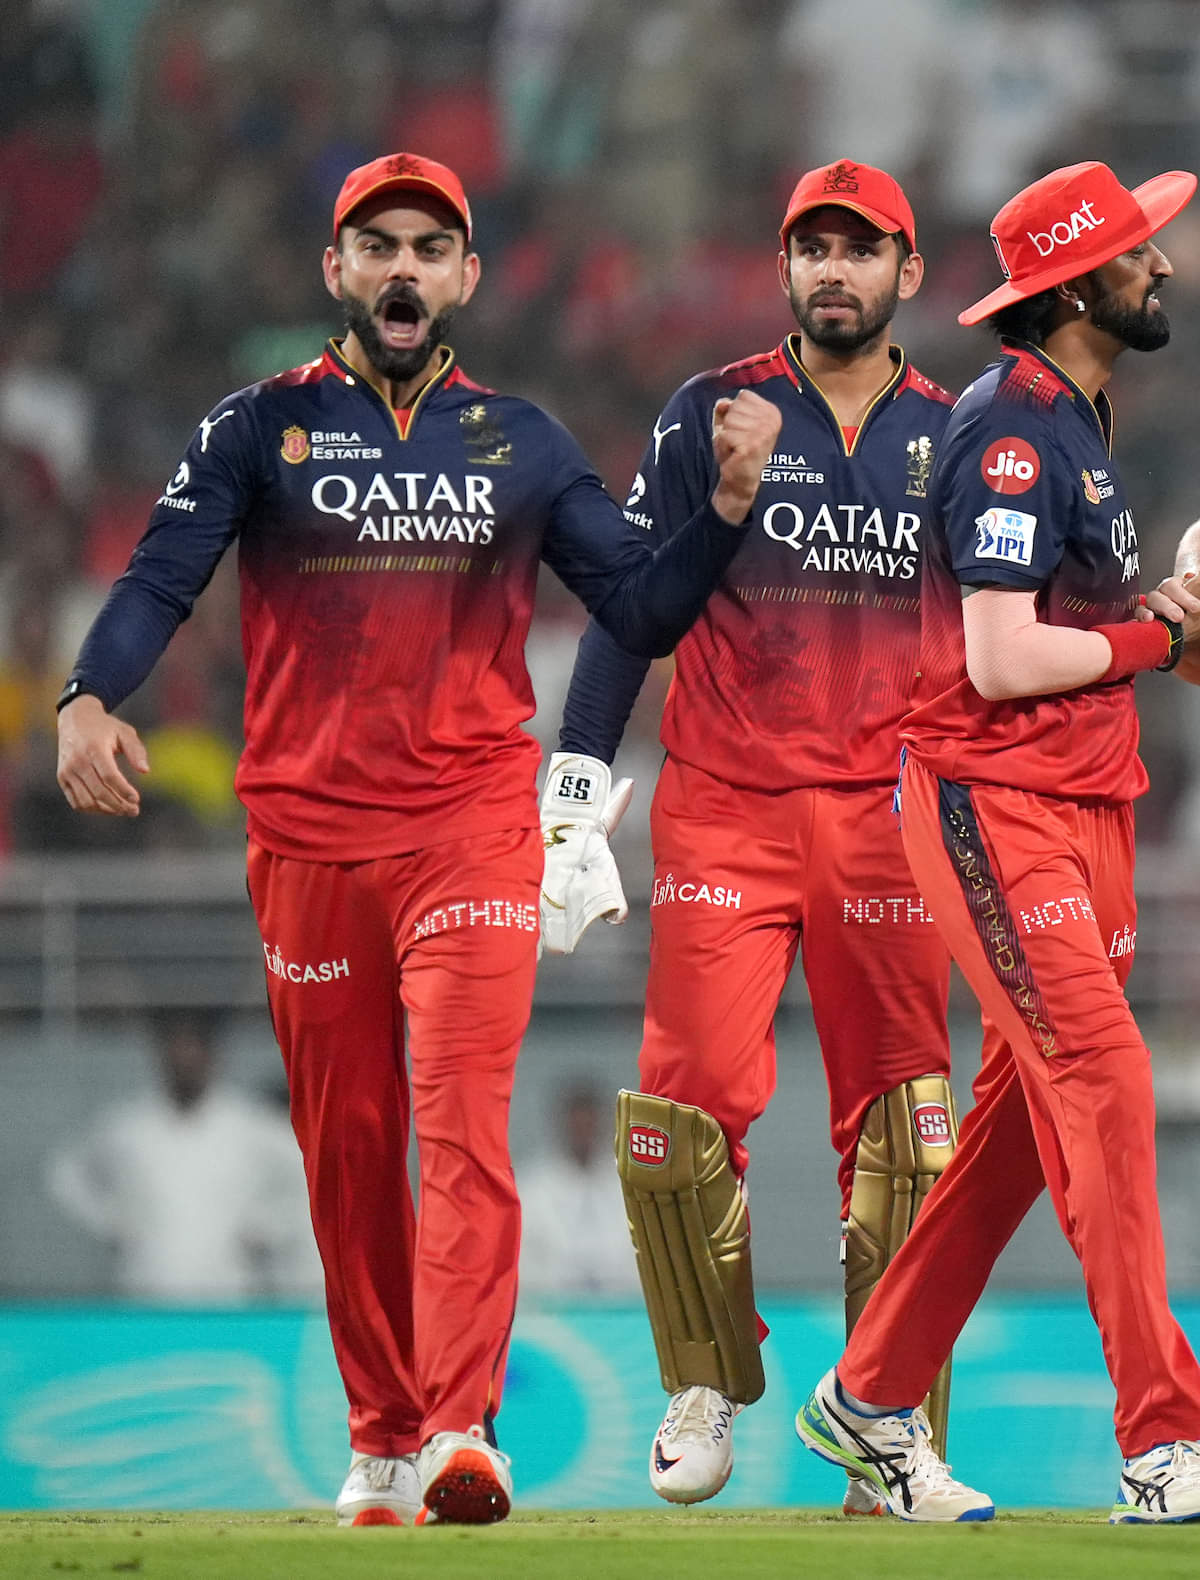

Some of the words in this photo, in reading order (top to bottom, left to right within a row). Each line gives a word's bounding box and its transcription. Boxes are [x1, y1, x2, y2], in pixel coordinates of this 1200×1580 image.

[1026, 199, 1106, 257] boAt
[310, 431, 362, 443] BIRLA
[311, 446, 383, 460] ESTATES
[987, 450, 1034, 480] Jio
[760, 469, 825, 485] ESTATES
[311, 472, 496, 522] QATAR
[356, 515, 496, 545] AIRWAYS
[762, 501, 922, 553] QATAR
[1001, 527, 1025, 540] TATA
[801, 546, 919, 580] AIRWAYS
[995, 535, 1029, 562] IPL
[414, 899, 537, 940] NOTHING
[1015, 978, 1058, 1059] ROYAL
[919, 1113, 948, 1137] SS
[631, 1132, 665, 1159] SS
